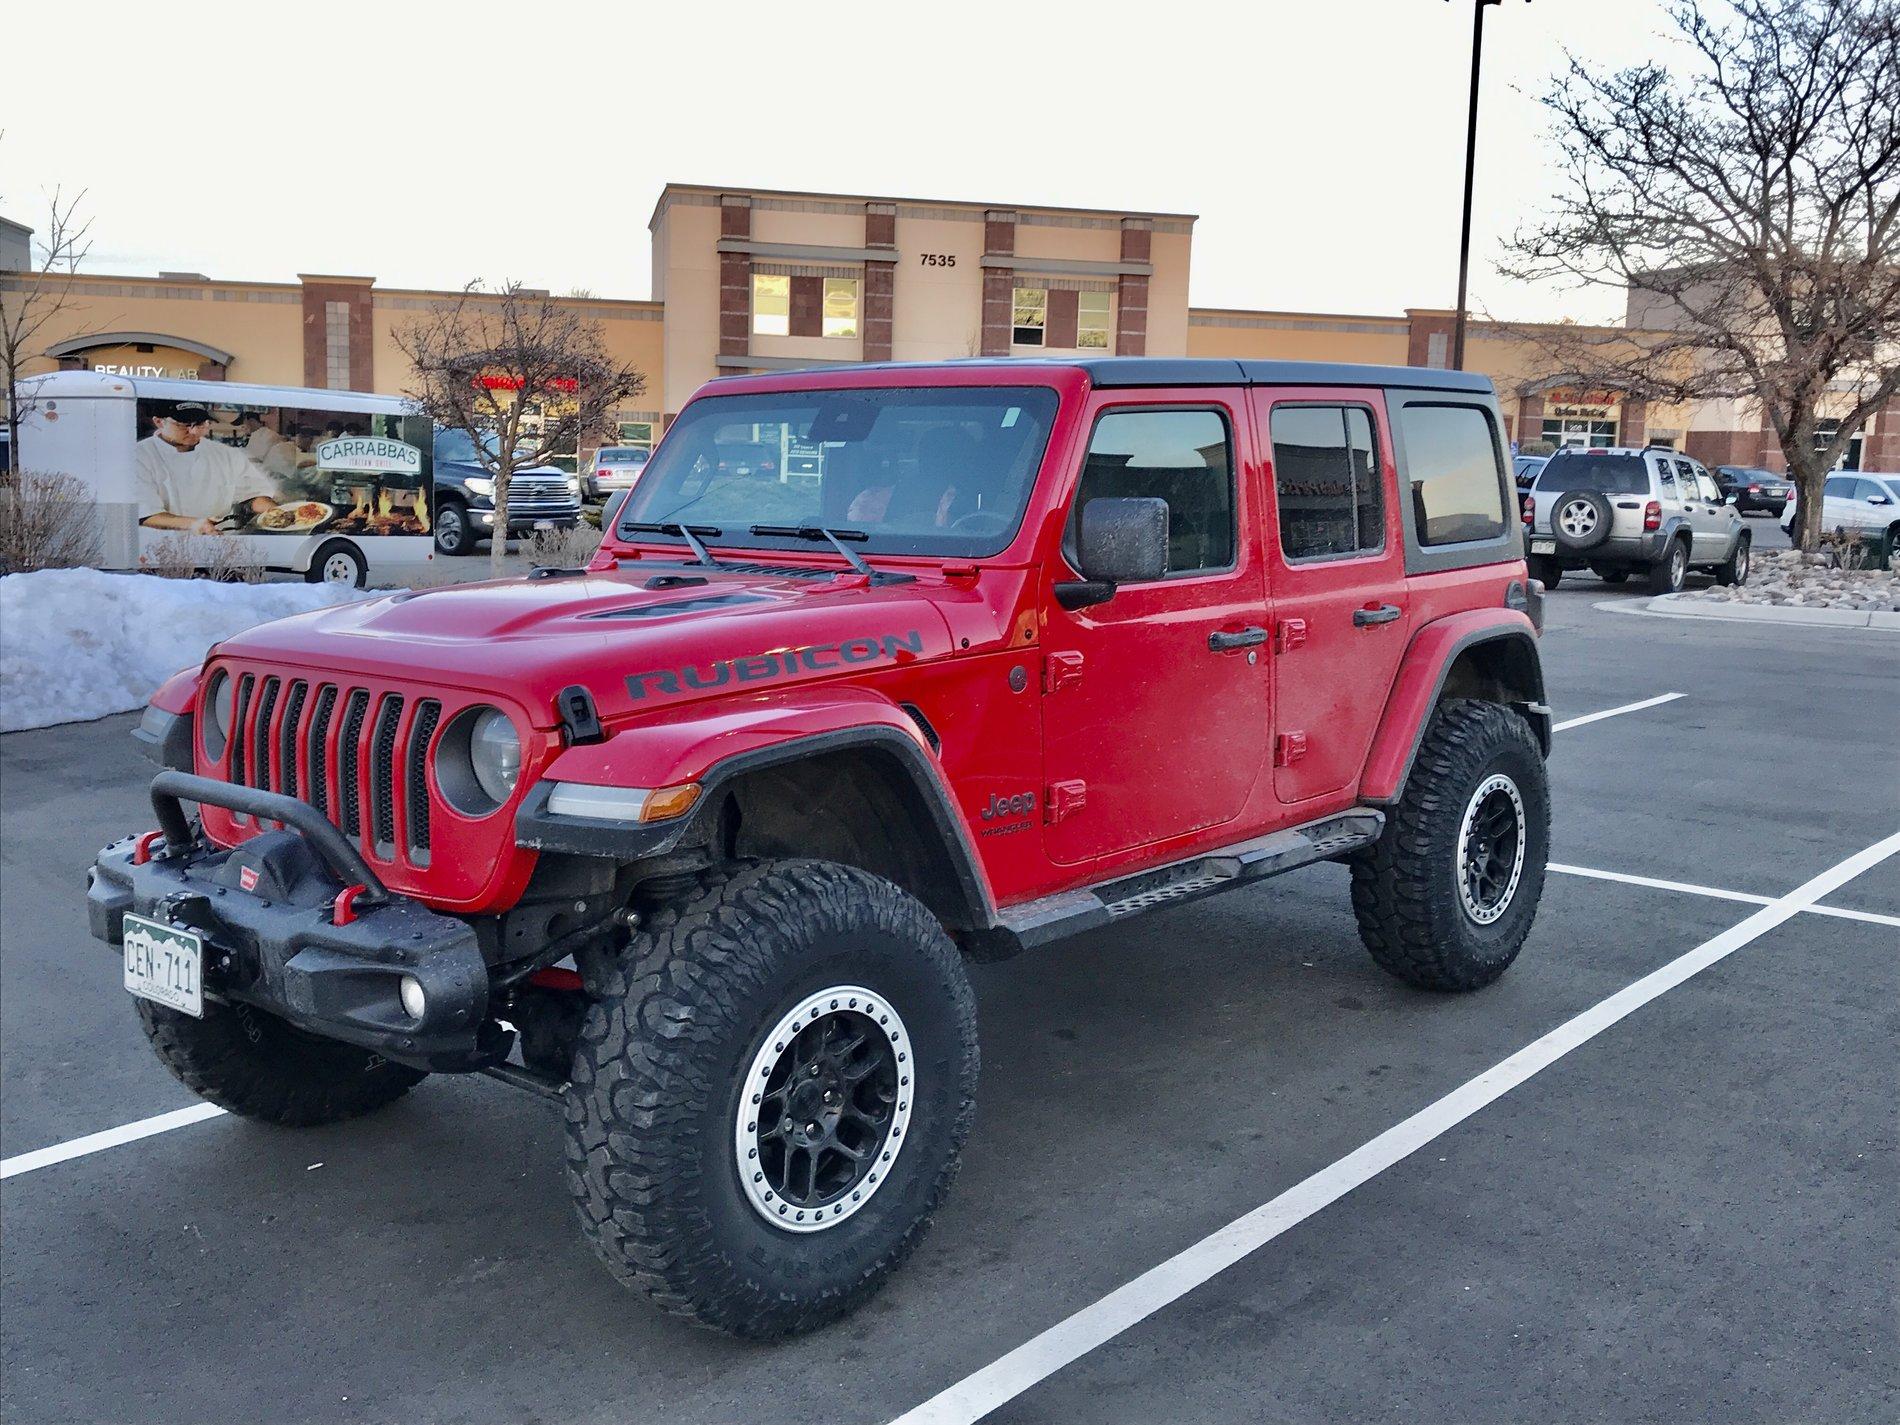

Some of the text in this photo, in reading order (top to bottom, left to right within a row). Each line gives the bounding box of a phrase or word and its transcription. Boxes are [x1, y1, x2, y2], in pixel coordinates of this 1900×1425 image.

[920, 253, 956, 267] 7535
[94, 364, 163, 378] BEAUTY
[321, 442, 417, 465] CARRABBA'S
[624, 630, 923, 701] RUBICON
[981, 791, 1034, 820] Jeep
